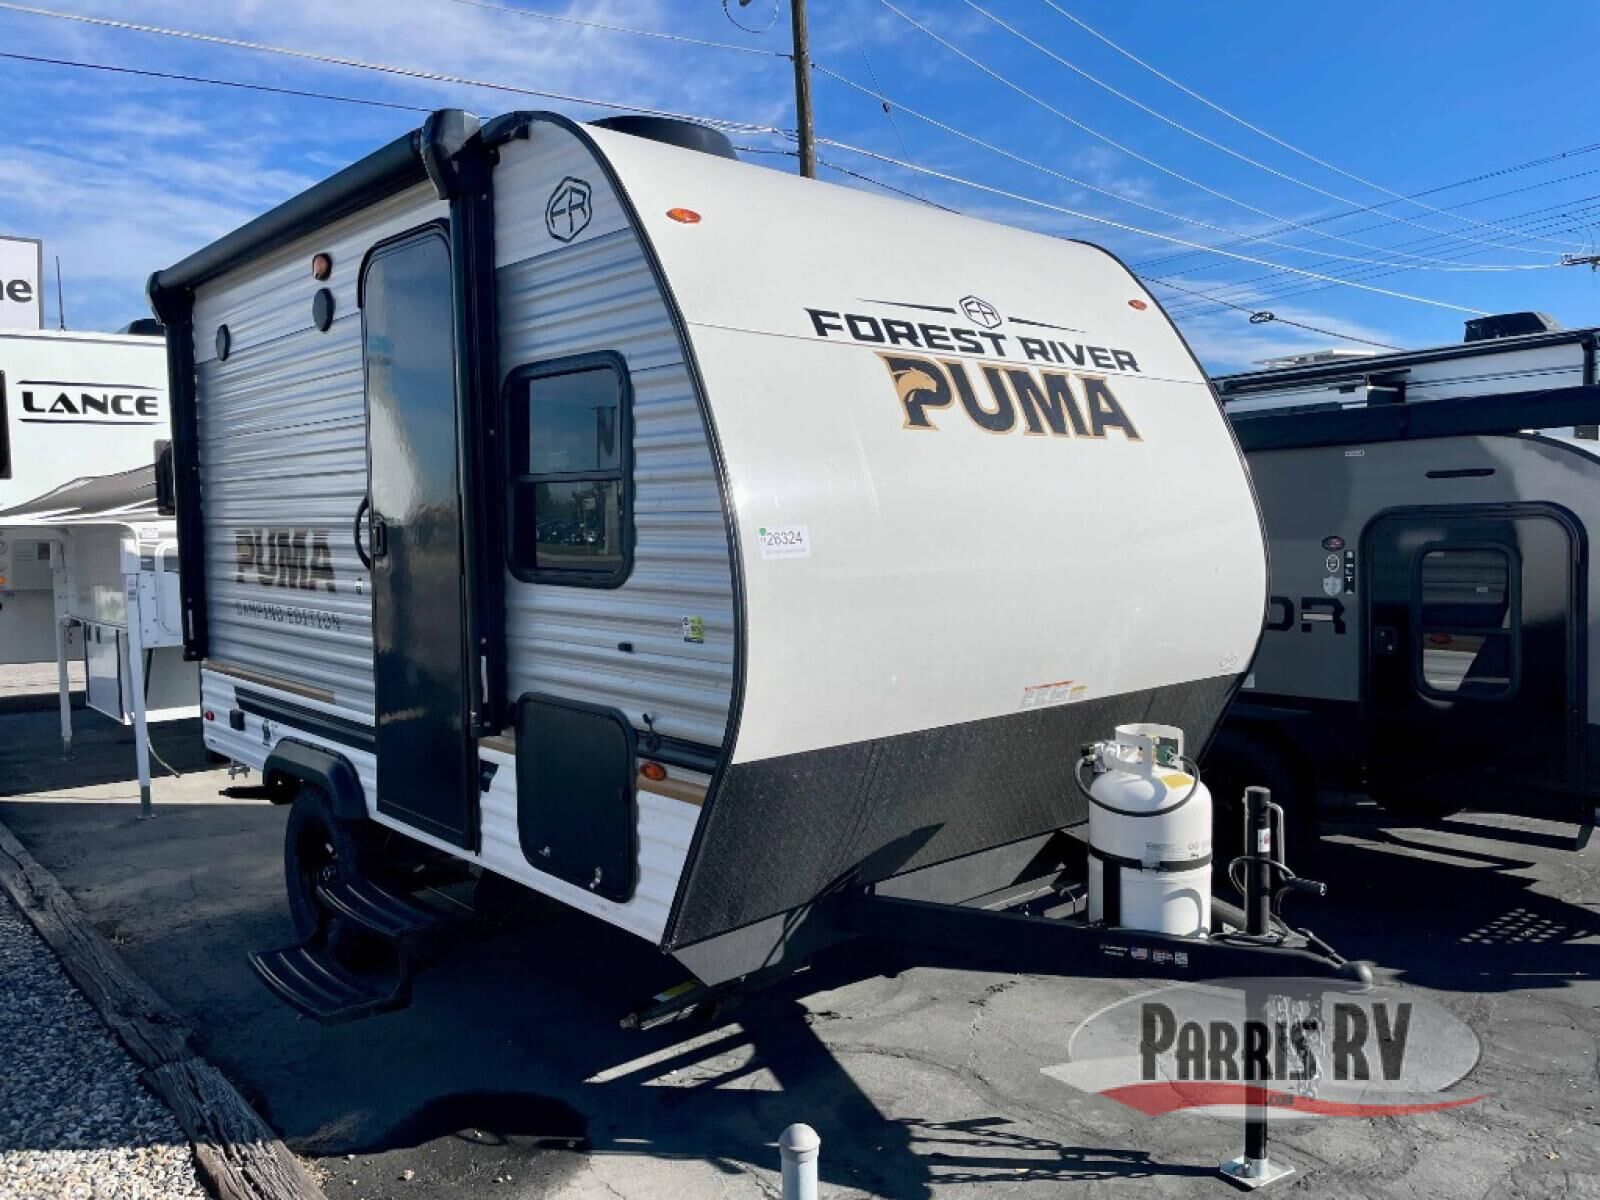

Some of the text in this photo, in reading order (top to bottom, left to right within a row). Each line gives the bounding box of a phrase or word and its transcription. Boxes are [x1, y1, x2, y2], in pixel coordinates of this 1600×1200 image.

[804, 307, 1142, 373] FOREST RIVER
[21, 391, 159, 417] LANCE
[875, 351, 1144, 443] PUMA
[234, 528, 337, 594] PUMA
[766, 530, 803, 546] 26324
[287, 606, 342, 631] EDITION
